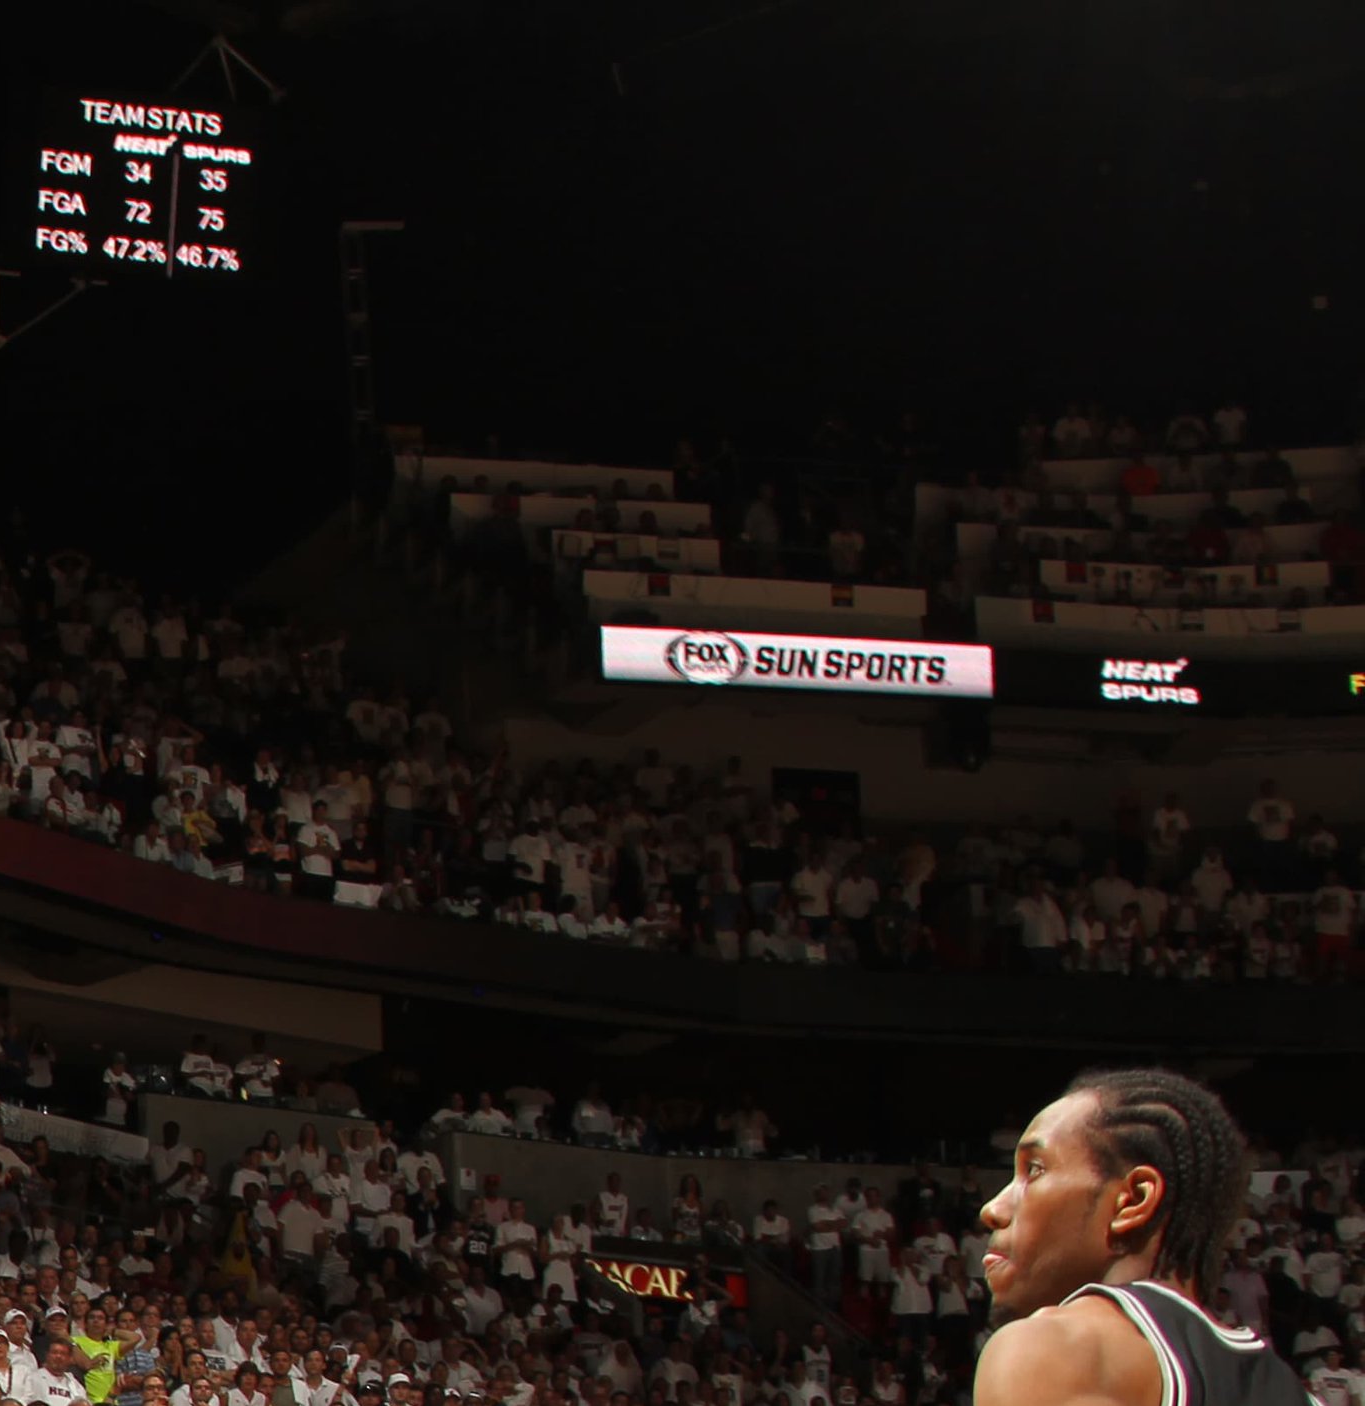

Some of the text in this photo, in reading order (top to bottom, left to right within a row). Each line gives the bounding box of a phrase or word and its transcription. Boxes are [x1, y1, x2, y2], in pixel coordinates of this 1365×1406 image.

[80, 99, 223, 136] TEAM STATS
[40, 149, 228, 193] FGM 34 35
[182, 143, 252, 165] SPURS
[37, 189, 226, 232] FGA 72 75
[35, 227, 241, 272] FG% 47.2% 46.7%
[682, 640, 730, 666] FOX
[753, 644, 946, 685] SUN SPORTS
[1101, 657, 1189, 683] HEAT
[1101, 682, 1201, 704] SPURS
